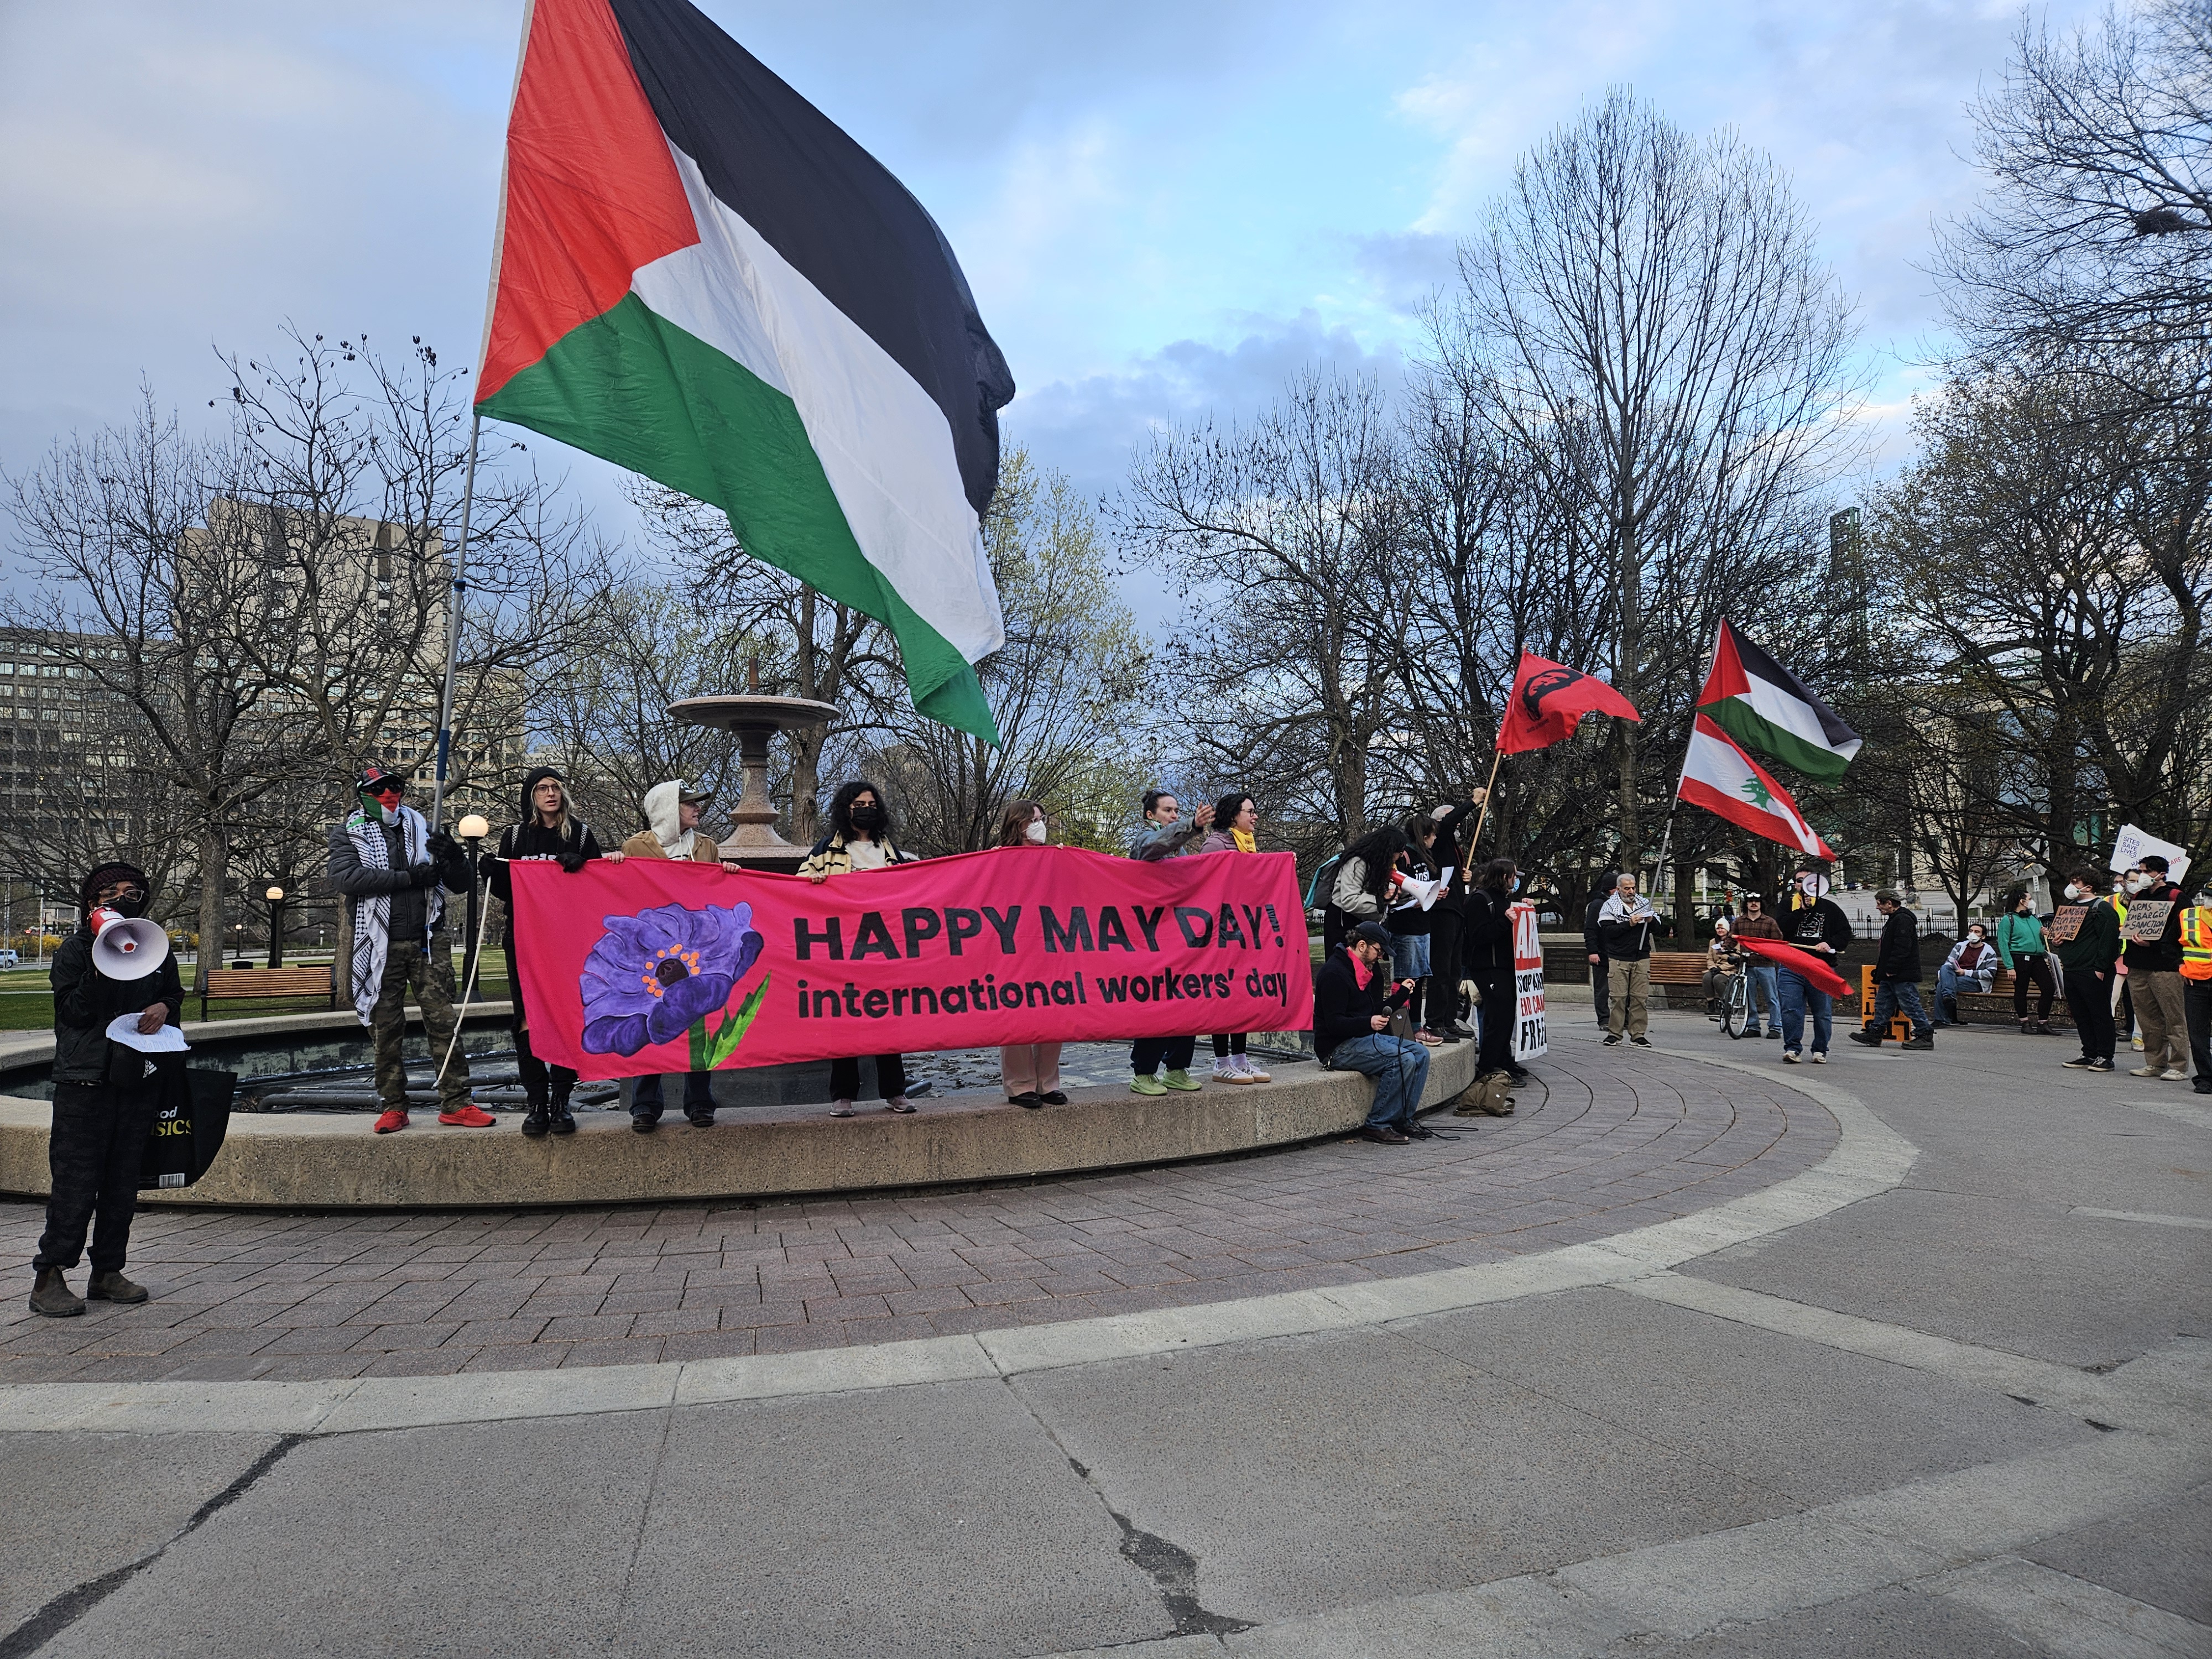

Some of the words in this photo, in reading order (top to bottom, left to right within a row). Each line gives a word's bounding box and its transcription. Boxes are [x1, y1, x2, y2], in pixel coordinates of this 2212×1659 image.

[2124, 836, 2140, 846] SITES
[2120, 847, 2137, 857] LIVES
[2122, 842, 2138, 852] SAVE
[2129, 902, 2153, 914] ARMS
[2053, 917, 2068, 925] FROM
[2126, 911, 2164, 921] EMBARGO
[794, 905, 1022, 961] HAPPY
[1039, 905, 1165, 953] MAY
[1173, 903, 1286, 950] DAY!
[797, 971, 1087, 1019] international
[1245, 968, 1288, 1008] day
[1520, 997, 1532, 1016] END
